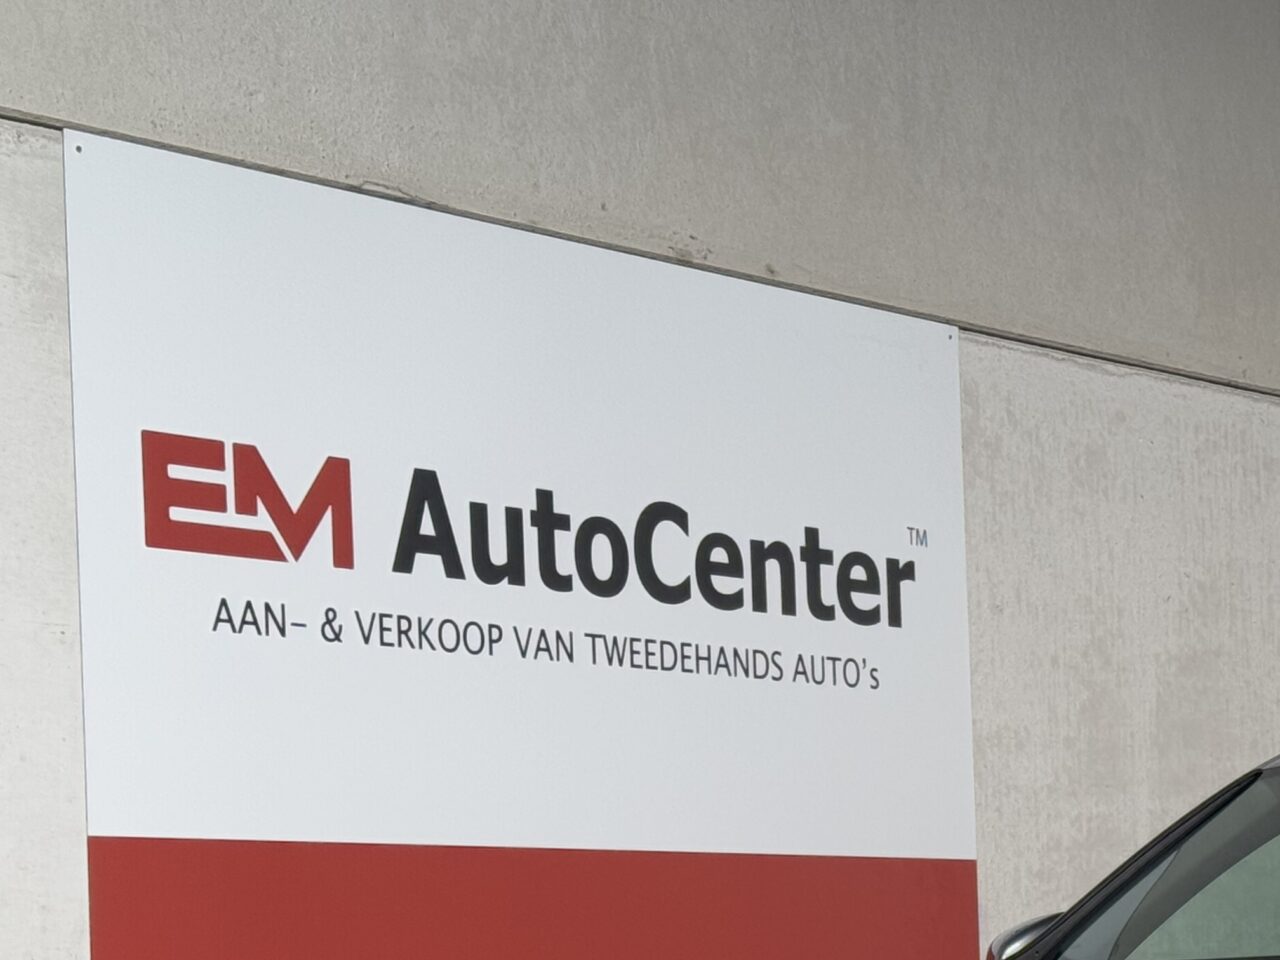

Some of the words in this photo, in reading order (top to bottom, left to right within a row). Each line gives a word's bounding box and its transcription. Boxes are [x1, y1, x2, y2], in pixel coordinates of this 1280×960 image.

[141, 429, 354, 570] EM
[391, 467, 916, 628] AutoCenter
[320, 607, 343, 643] &
[354, 610, 503, 656] VERKOOP
[513, 626, 574, 663] VAN
[584, 633, 784, 682] TWEEDEHANDS
[792, 653, 880, 690] AUTO's
